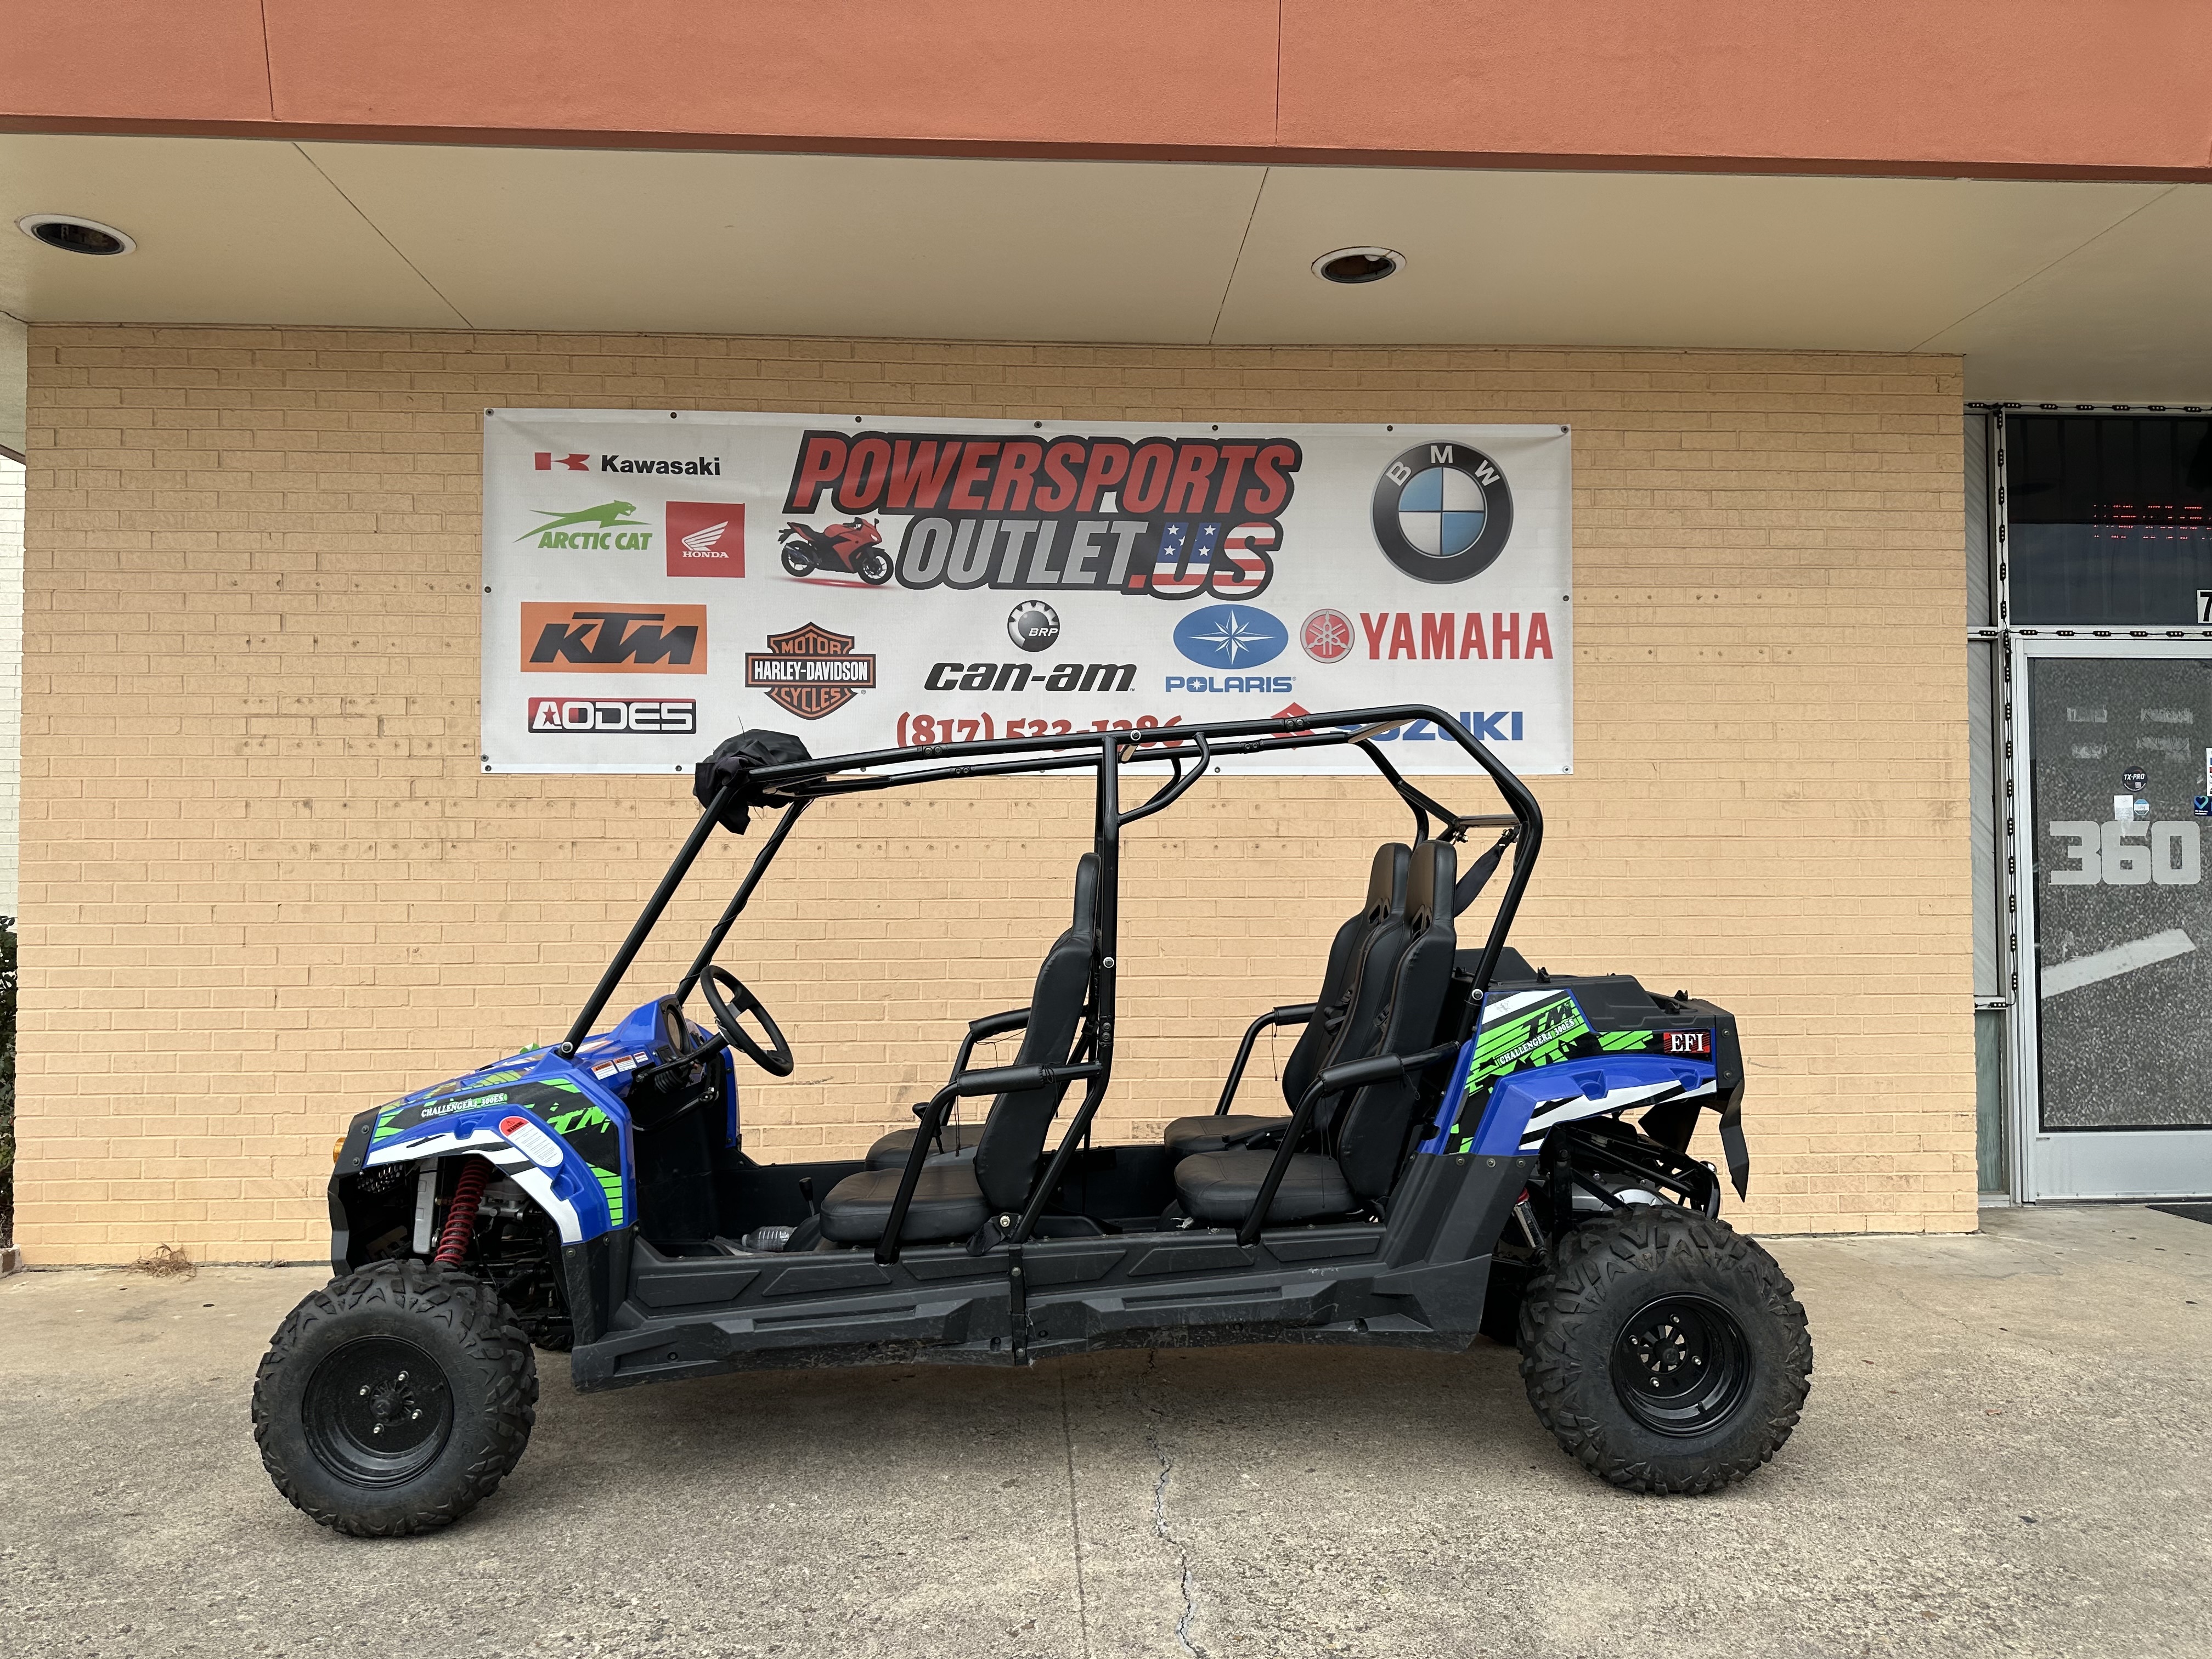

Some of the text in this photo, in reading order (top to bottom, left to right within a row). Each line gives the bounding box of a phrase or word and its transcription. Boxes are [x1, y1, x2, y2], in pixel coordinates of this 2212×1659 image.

[601, 455, 721, 476] Kawasaki
[783, 431, 1302, 520] POWERSPORTS
[1386, 445, 1500, 487] BMW
[538, 531, 653, 551] ARCTIC CAT
[682, 550, 729, 558] HONDA
[895, 516, 1283, 600] OUTLET.US
[529, 612, 699, 665] KTM
[781, 632, 842, 654] MOTOR
[1028, 628, 1058, 636] BRP
[1359, 612, 1553, 660] YAMAHA
[754, 661, 867, 680] HARLEY-DAVIDSON
[1165, 676, 1293, 693] POLARIS
[781, 687, 841, 712] CYCLES
[532, 701, 693, 731] AODES
[1330, 712, 1523, 741] ZUKI
[897, 712, 994, 748] (817)
[2049, 821, 2202, 885] 360
[1553, 1018, 1575, 1036] 300ES
[1670, 1034, 1704, 1052] EFI
[480, 1093, 504, 1107] 300ES
